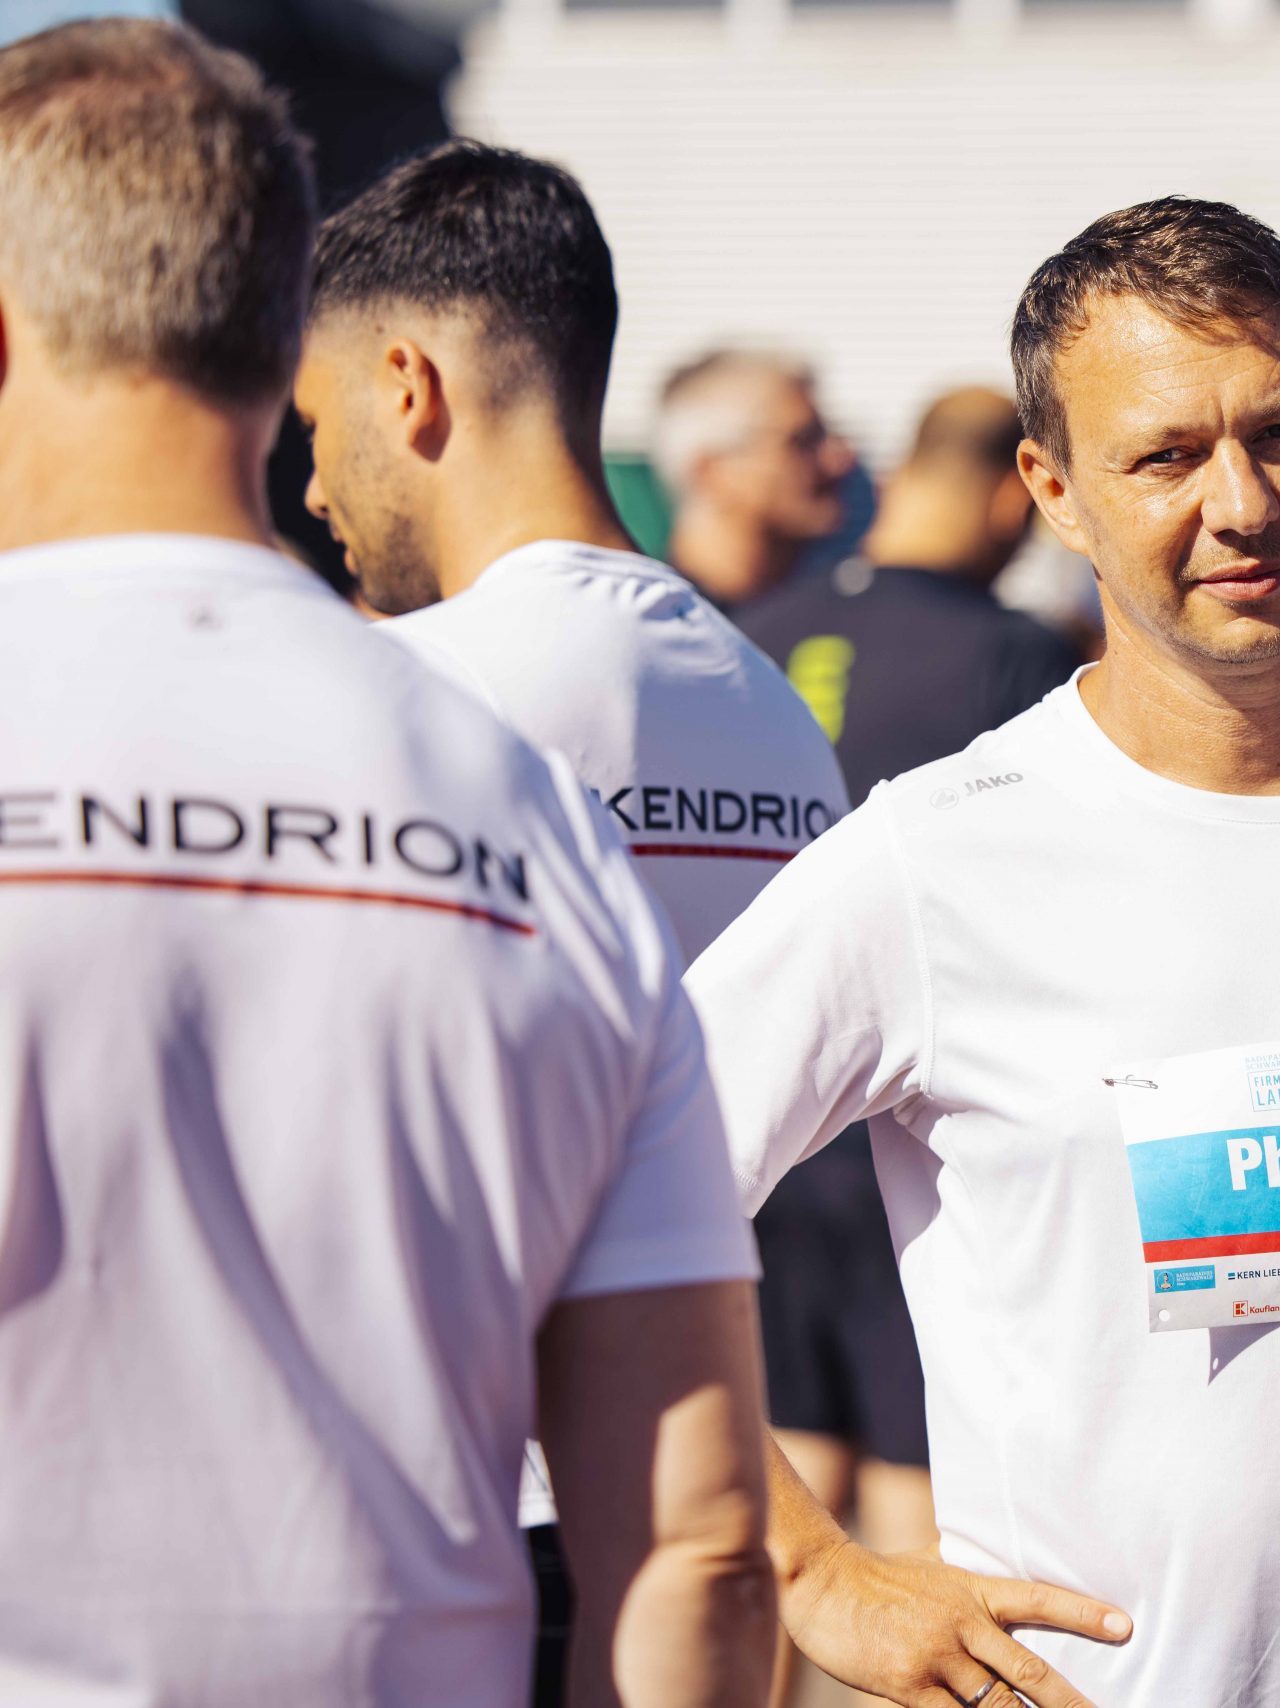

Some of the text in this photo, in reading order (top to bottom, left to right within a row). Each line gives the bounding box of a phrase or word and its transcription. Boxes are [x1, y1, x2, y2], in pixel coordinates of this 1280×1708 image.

[963, 772, 1024, 797] JAKO
[590, 786, 838, 841] KENDRIO
[1237, 1270, 1262, 1280] KERN
